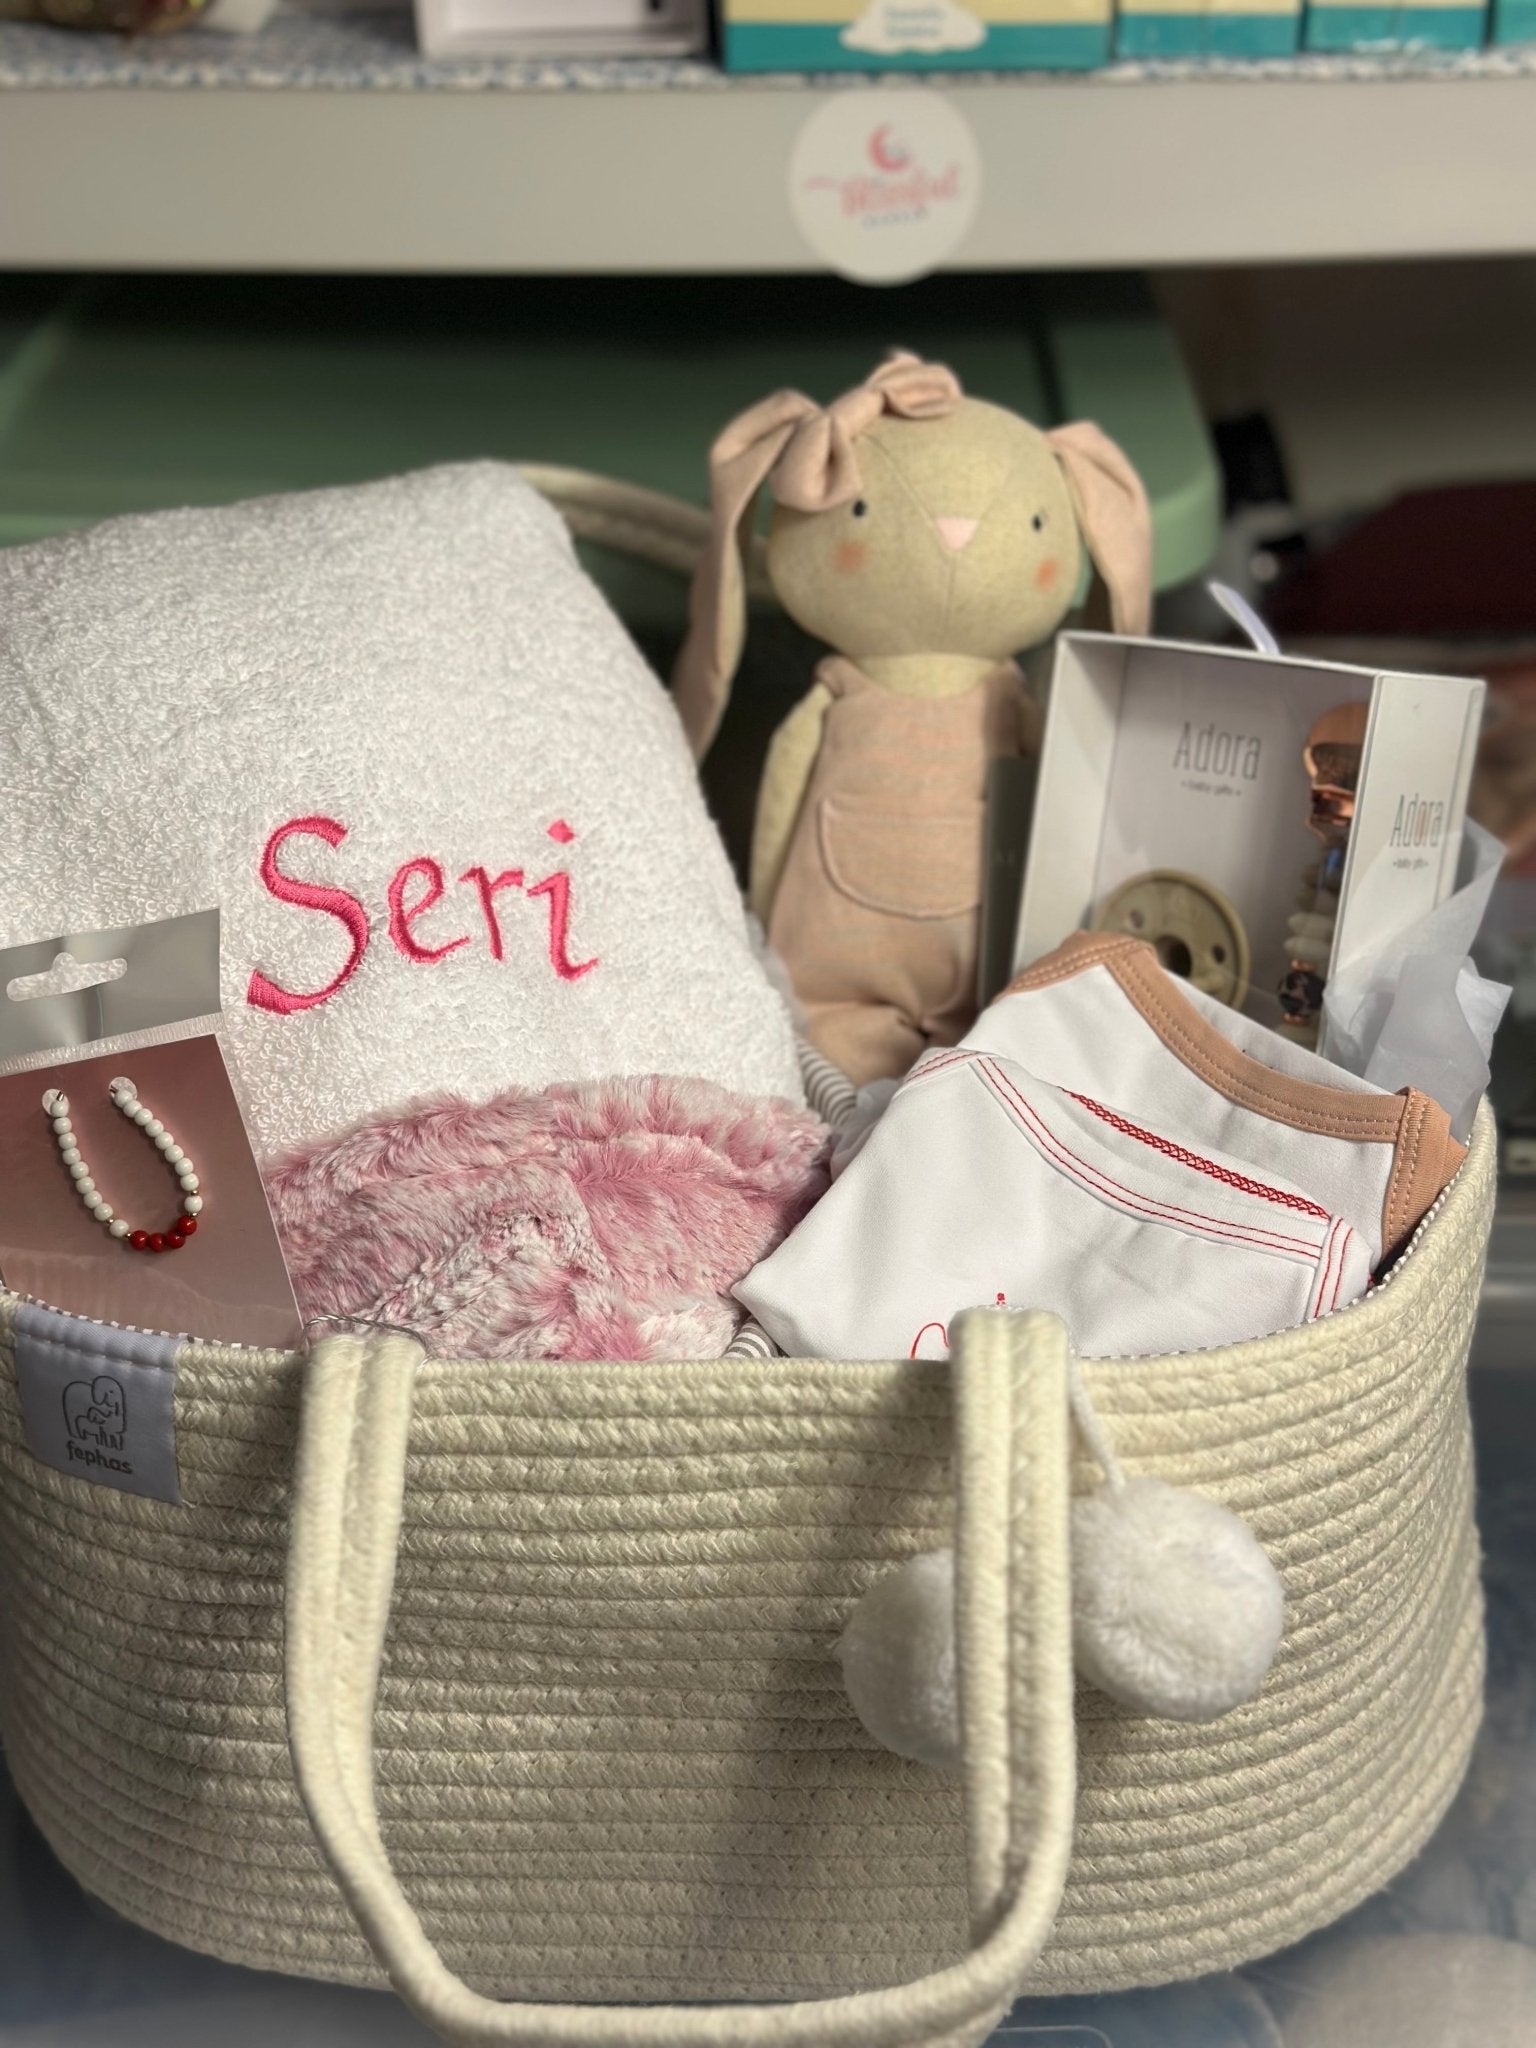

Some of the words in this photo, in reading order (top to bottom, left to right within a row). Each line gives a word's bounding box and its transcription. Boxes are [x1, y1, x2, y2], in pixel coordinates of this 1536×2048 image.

[1172, 721, 1262, 780] Adora
[1390, 793, 1444, 848] Adora
[246, 816, 600, 1016] Seri
[66, 1440, 133, 1475] fephas
